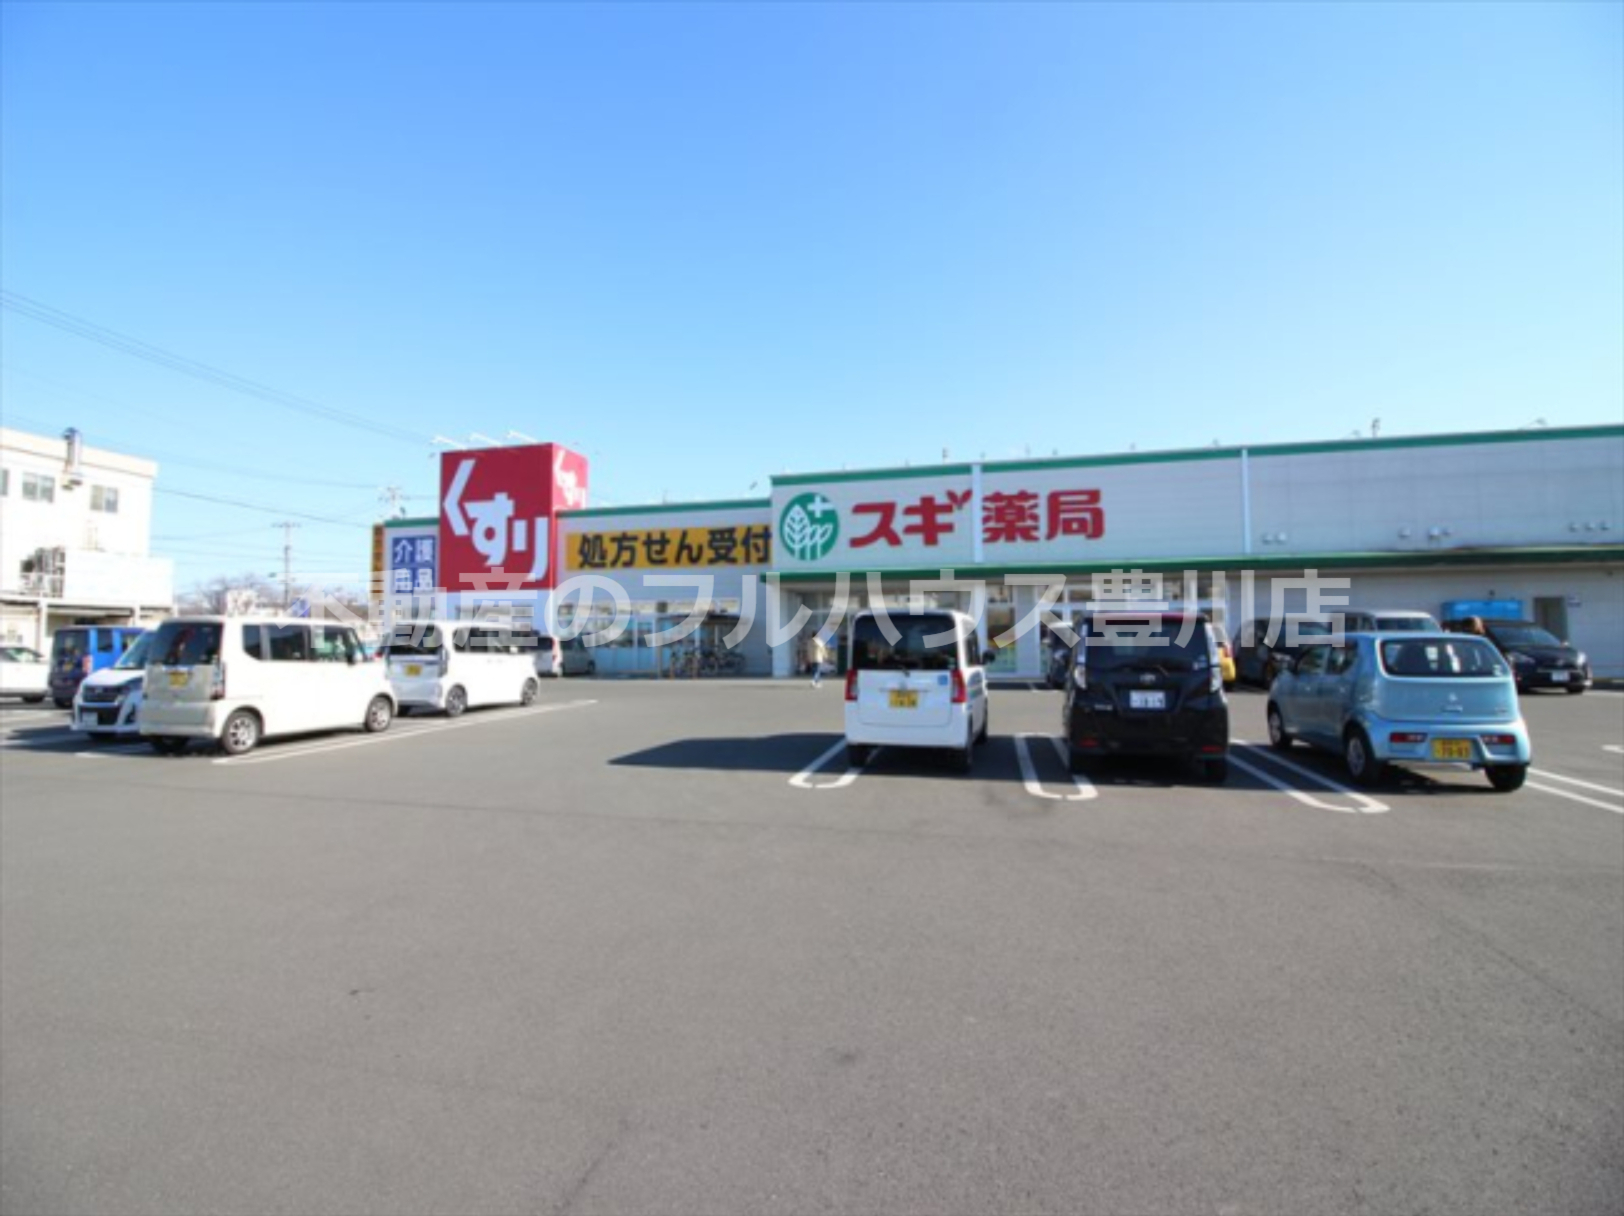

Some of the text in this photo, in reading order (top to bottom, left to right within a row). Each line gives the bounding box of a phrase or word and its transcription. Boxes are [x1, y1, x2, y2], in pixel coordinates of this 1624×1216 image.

[443, 458, 550, 582] くすり
[579, 524, 772, 569] 処方せん受付
[848, 489, 1106, 549] スギ薬局
